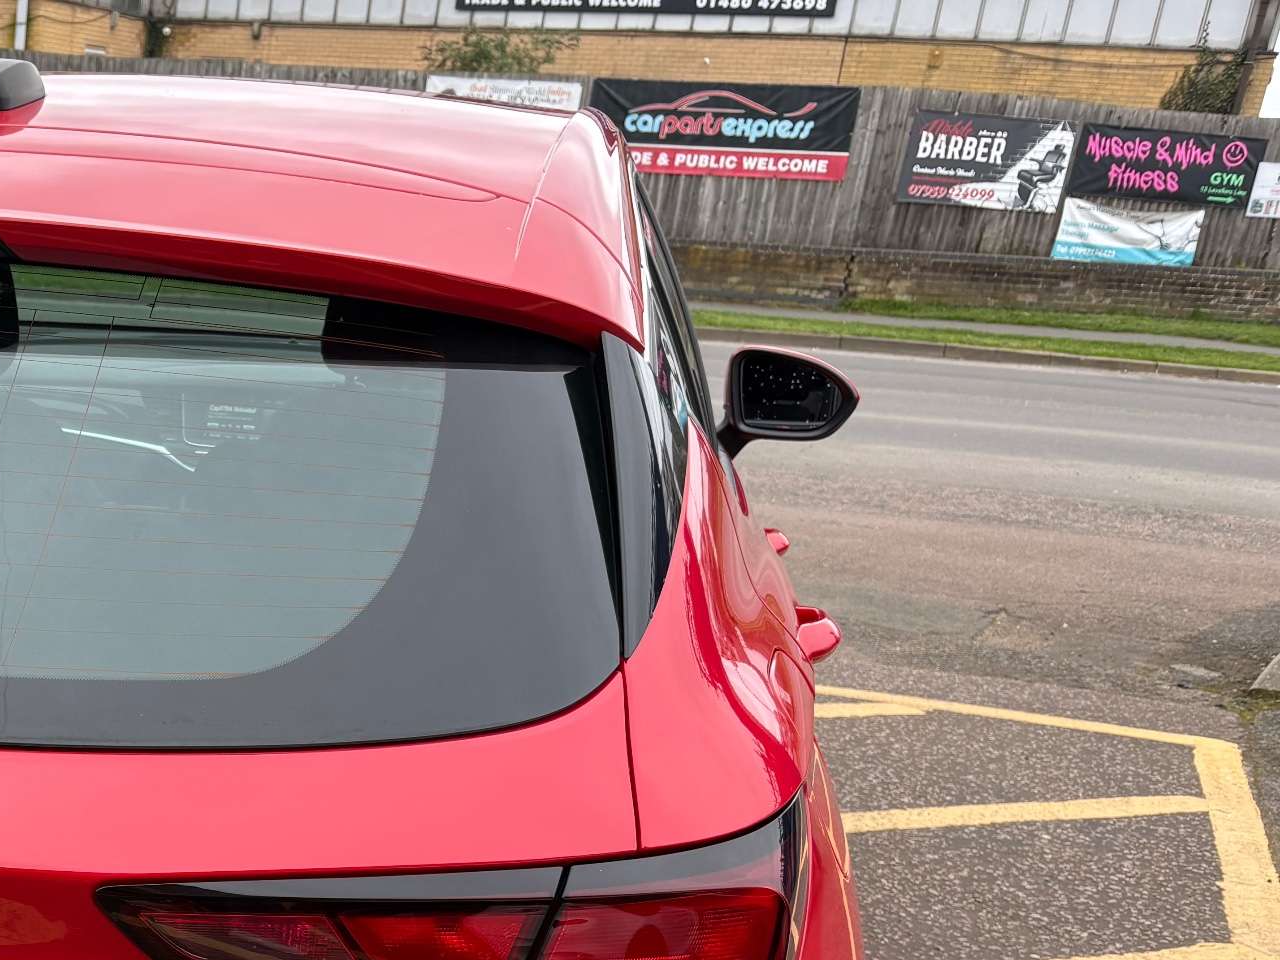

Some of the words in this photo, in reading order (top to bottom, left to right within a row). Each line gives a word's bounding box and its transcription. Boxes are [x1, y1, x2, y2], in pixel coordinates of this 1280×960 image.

[588, 0, 662, 8] WELCOME
[916, 130, 1007, 165] BARBER
[1085, 132, 1153, 162] Muscle
[1172, 138, 1217, 170] Mind
[656, 152, 670, 167] &
[674, 153, 738, 170] PUBLIC
[742, 156, 829, 173] WELCOME
[1210, 171, 1246, 187] GYM
